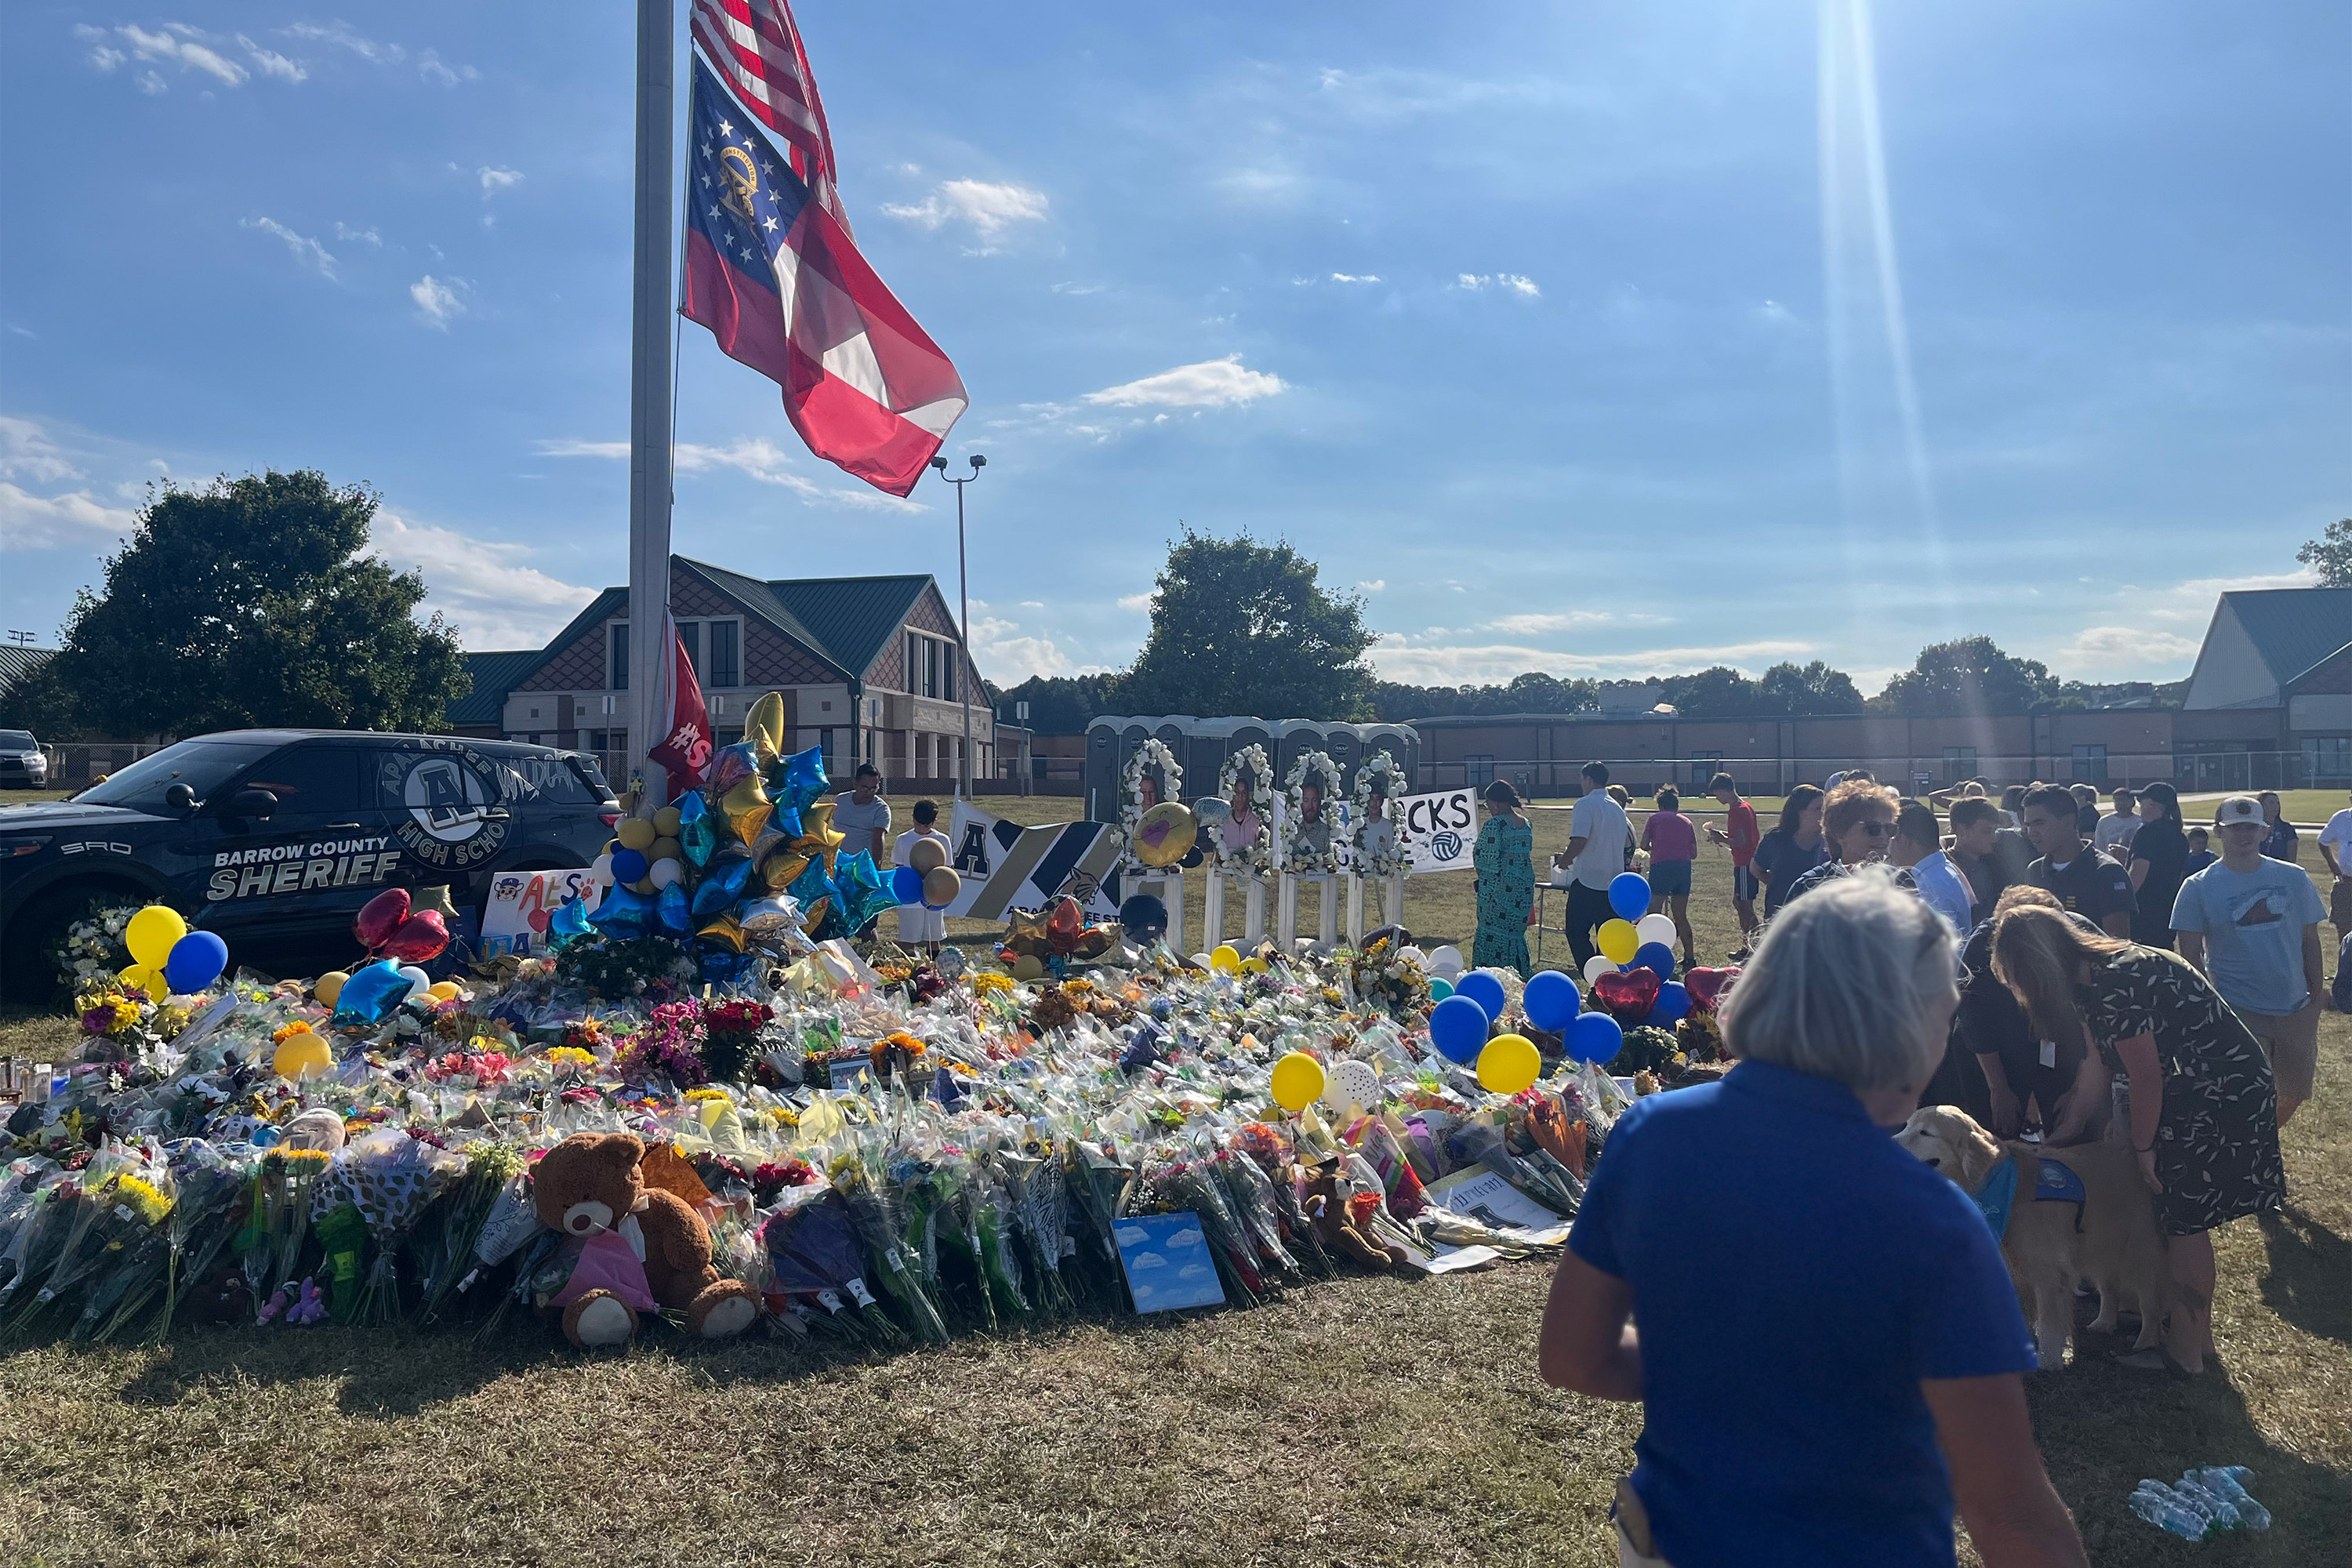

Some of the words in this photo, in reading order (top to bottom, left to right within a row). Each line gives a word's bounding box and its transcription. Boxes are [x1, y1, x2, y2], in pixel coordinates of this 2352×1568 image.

[722, 147, 755, 182] CONSTITUTION
[417, 764, 487, 831] A
[1398, 794, 1471, 833] CKS
[60, 841, 132, 855] SRO
[215, 844, 304, 867] BARROW
[309, 837, 389, 857] COUNTY
[397, 820, 449, 865] HIGH
[954, 820, 991, 881] A
[206, 851, 401, 901] SHERIFF
[518, 873, 582, 909] AES
